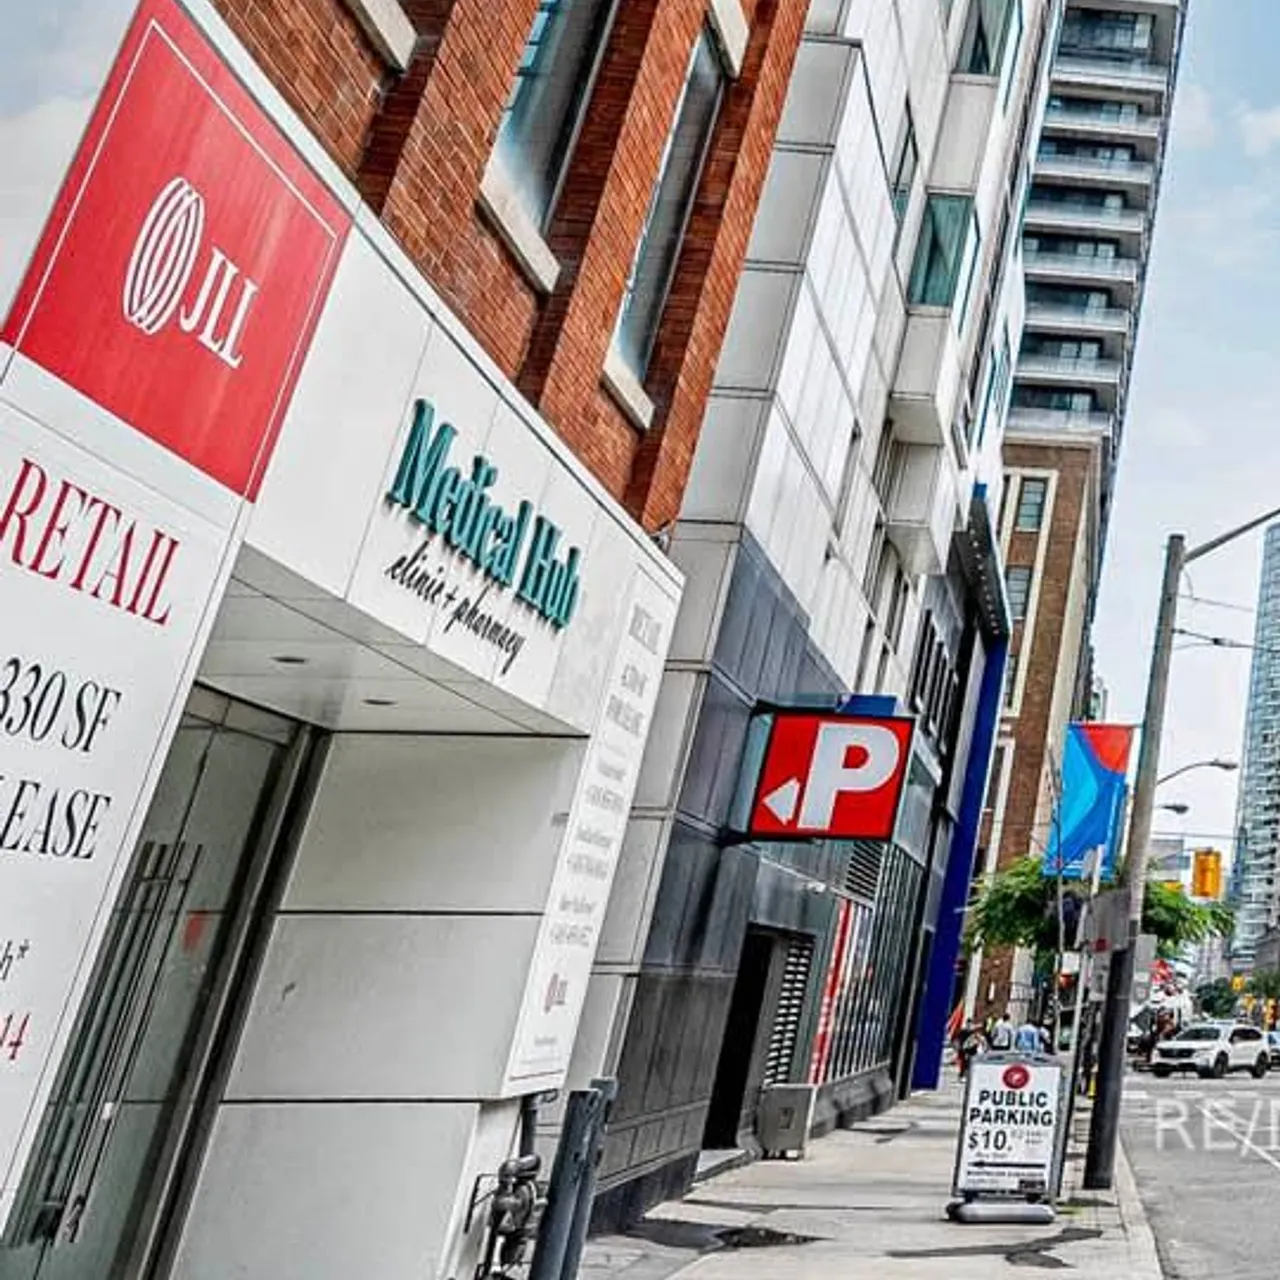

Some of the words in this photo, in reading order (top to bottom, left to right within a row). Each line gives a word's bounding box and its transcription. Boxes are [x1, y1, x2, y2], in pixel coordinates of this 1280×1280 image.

[179, 246, 259, 369] JLL
[0, 457, 180, 626] RETAIL
[385, 398, 532, 588] Medical
[515, 515, 580, 630] Hub
[384, 540, 446, 605] clinic
[444, 581, 526, 676] pharmacy
[61, 680, 122, 752] SF
[0, 775, 112, 859] EASE
[797, 721, 900, 829] P
[969, 1107, 1054, 1127] PARKING
[979, 1090, 1048, 1107] PUBLIC
